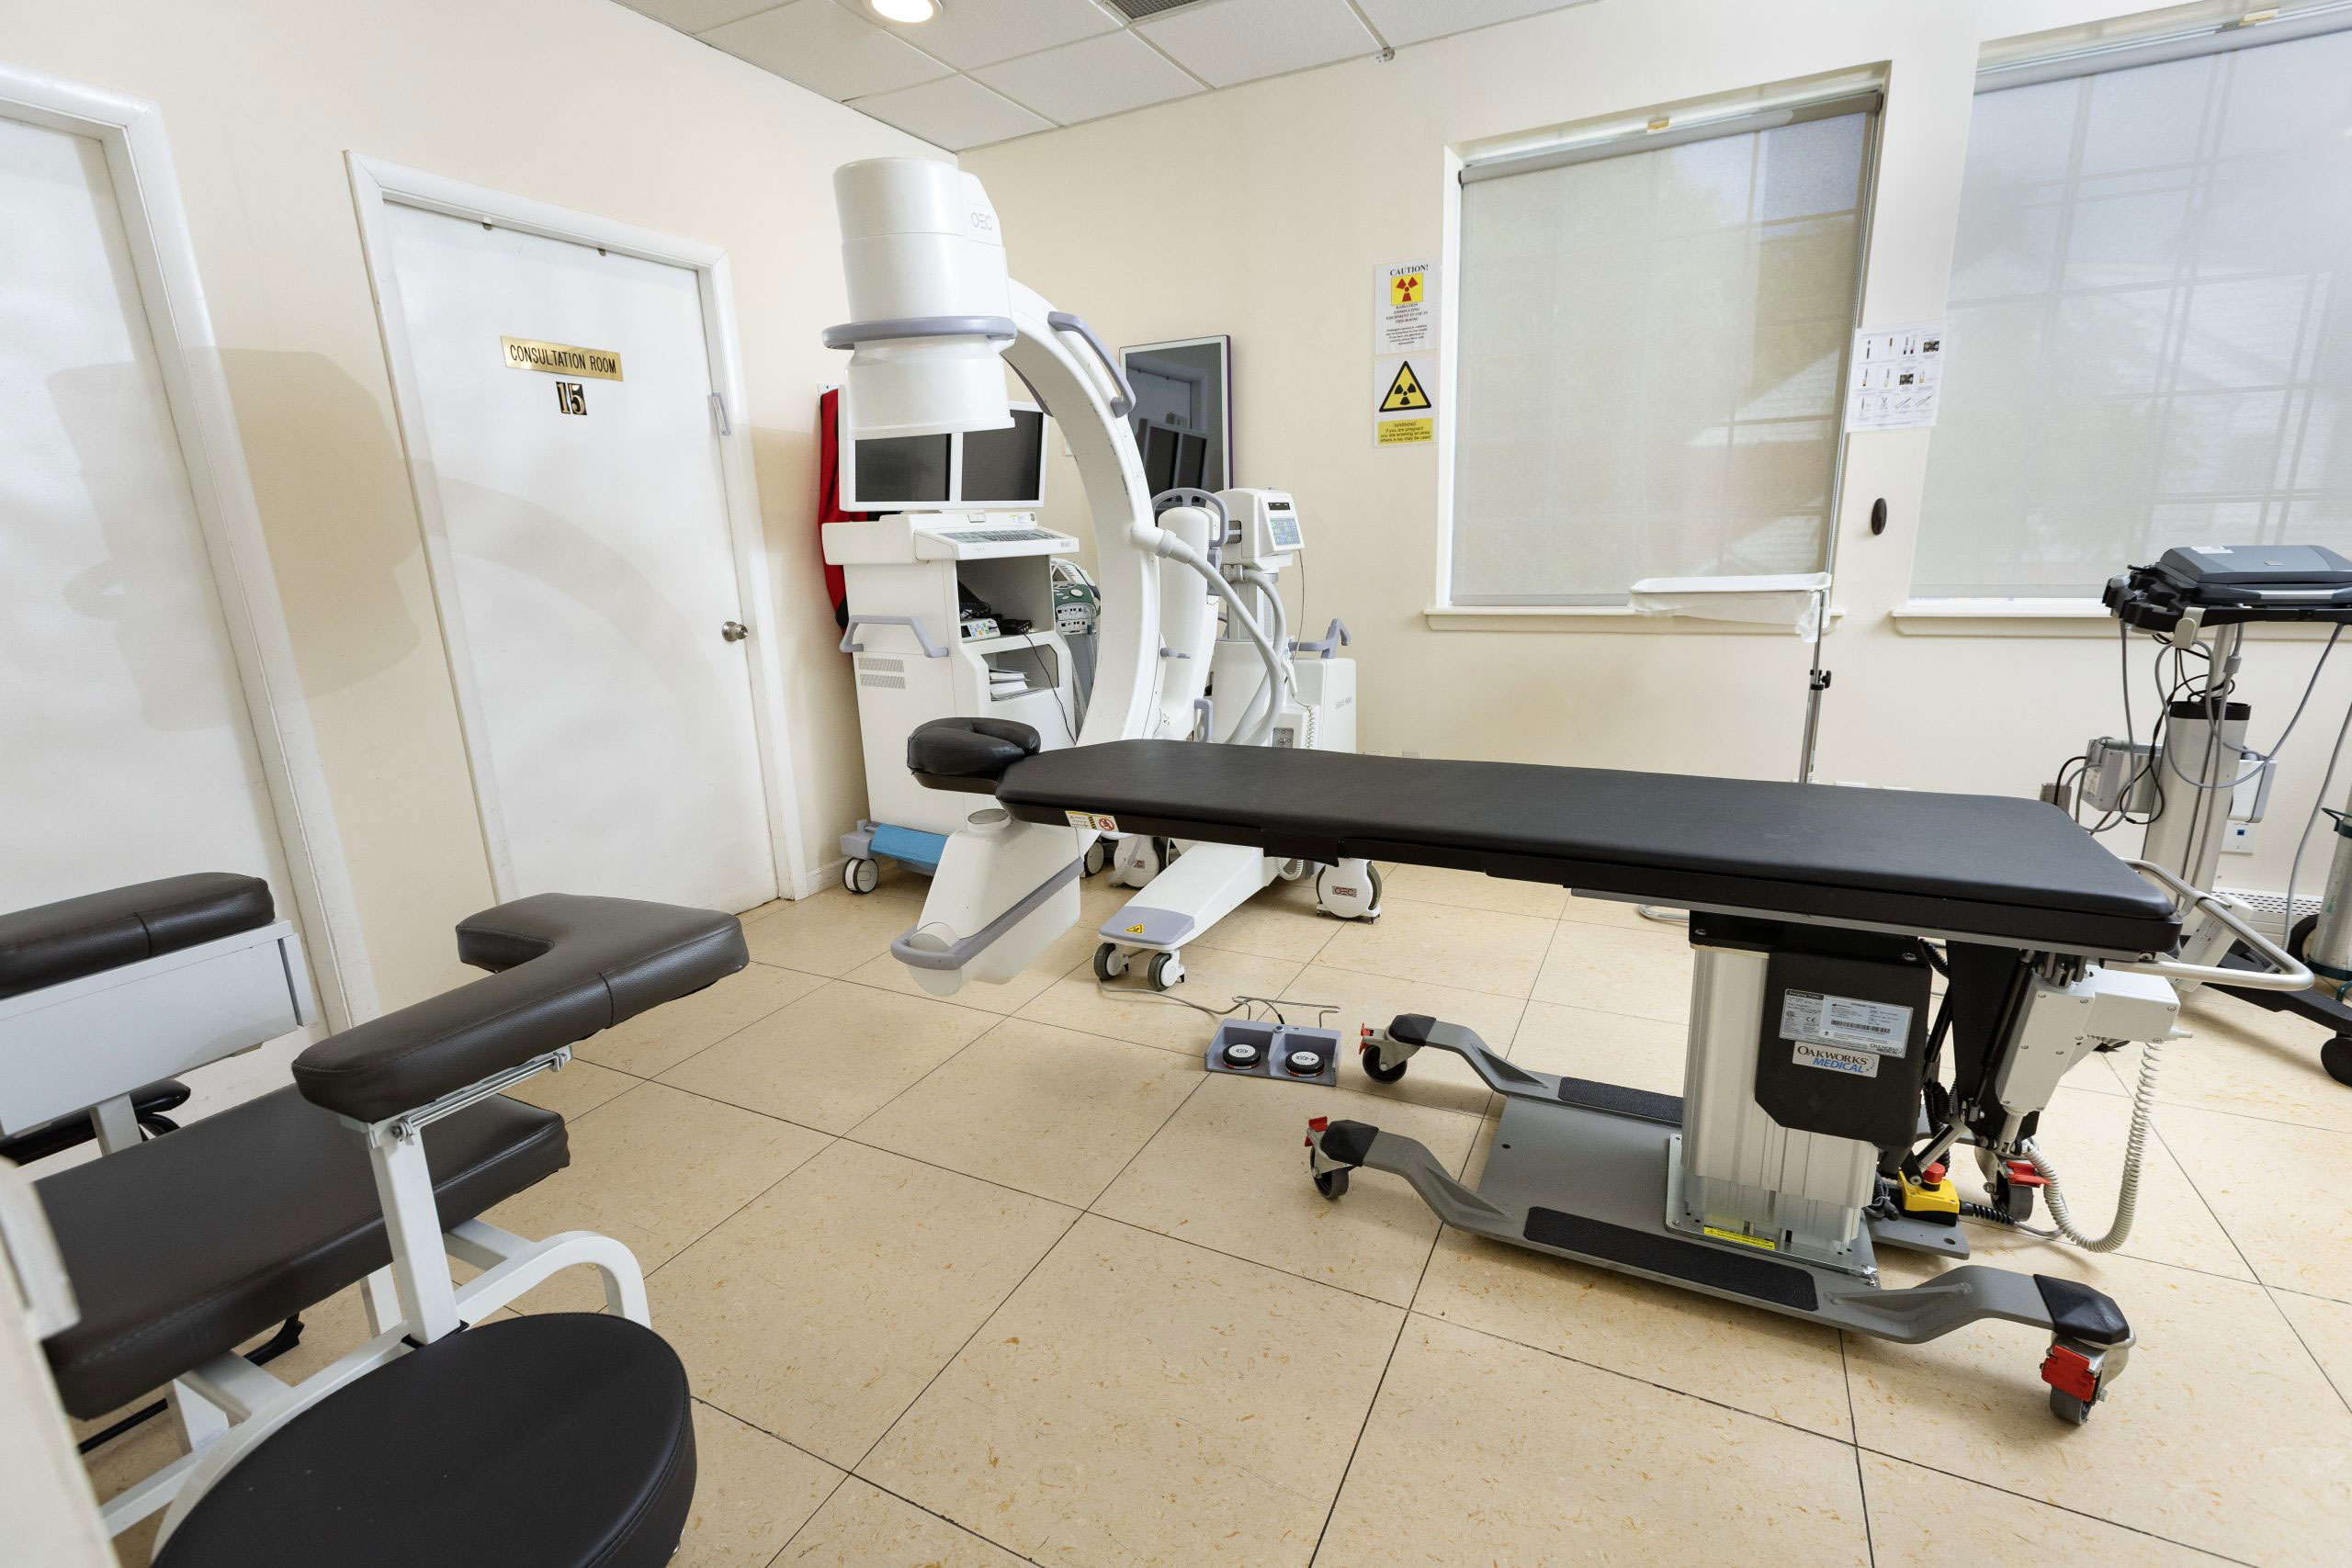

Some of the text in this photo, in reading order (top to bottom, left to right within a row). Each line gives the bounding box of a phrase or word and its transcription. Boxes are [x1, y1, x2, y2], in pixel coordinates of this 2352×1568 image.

[970, 212, 992, 231] OEC
[1389, 265, 1429, 276] CAUTION!
[510, 344, 616, 374] CONSULTATION ROOM
[556, 381, 587, 415] 15
[1334, 887, 1354, 896] OEC
[1797, 1046, 1869, 1066] OAKWORKS
[1812, 1058, 1864, 1073] MEDICAL
